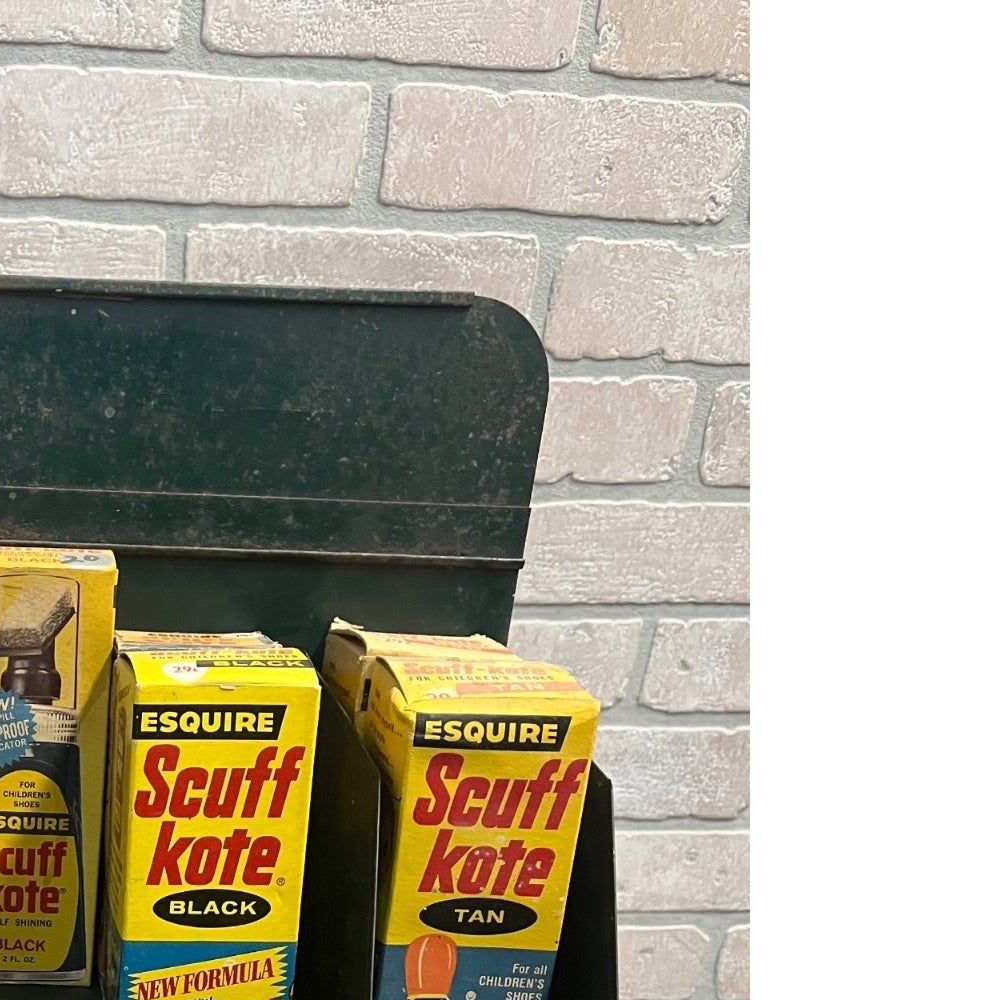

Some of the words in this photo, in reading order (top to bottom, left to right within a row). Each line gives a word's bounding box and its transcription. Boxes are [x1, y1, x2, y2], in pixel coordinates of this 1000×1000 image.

[403, 662, 547, 675] Scuff-kote
[140, 711, 274, 734] ESQUIRE
[424, 720, 558, 744] ESQUIRE
[20, 781, 36, 789] FOR
[134, 744, 306, 818] Scuff
[3, 790, 51, 799] CHILDREN'S
[413, 753, 588, 830] Scuff
[145, 821, 282, 886] kote
[417, 829, 556, 897] kote
[169, 900, 257, 915] BLACK
[15, 919, 53, 928] SHINING
[454, 909, 506, 924] TAN
[181, 957, 275, 995] FORMULA
[512, 963, 531, 975] For
[533, 964, 547, 975] all
[479, 976, 545, 989] CHILDREN'S
